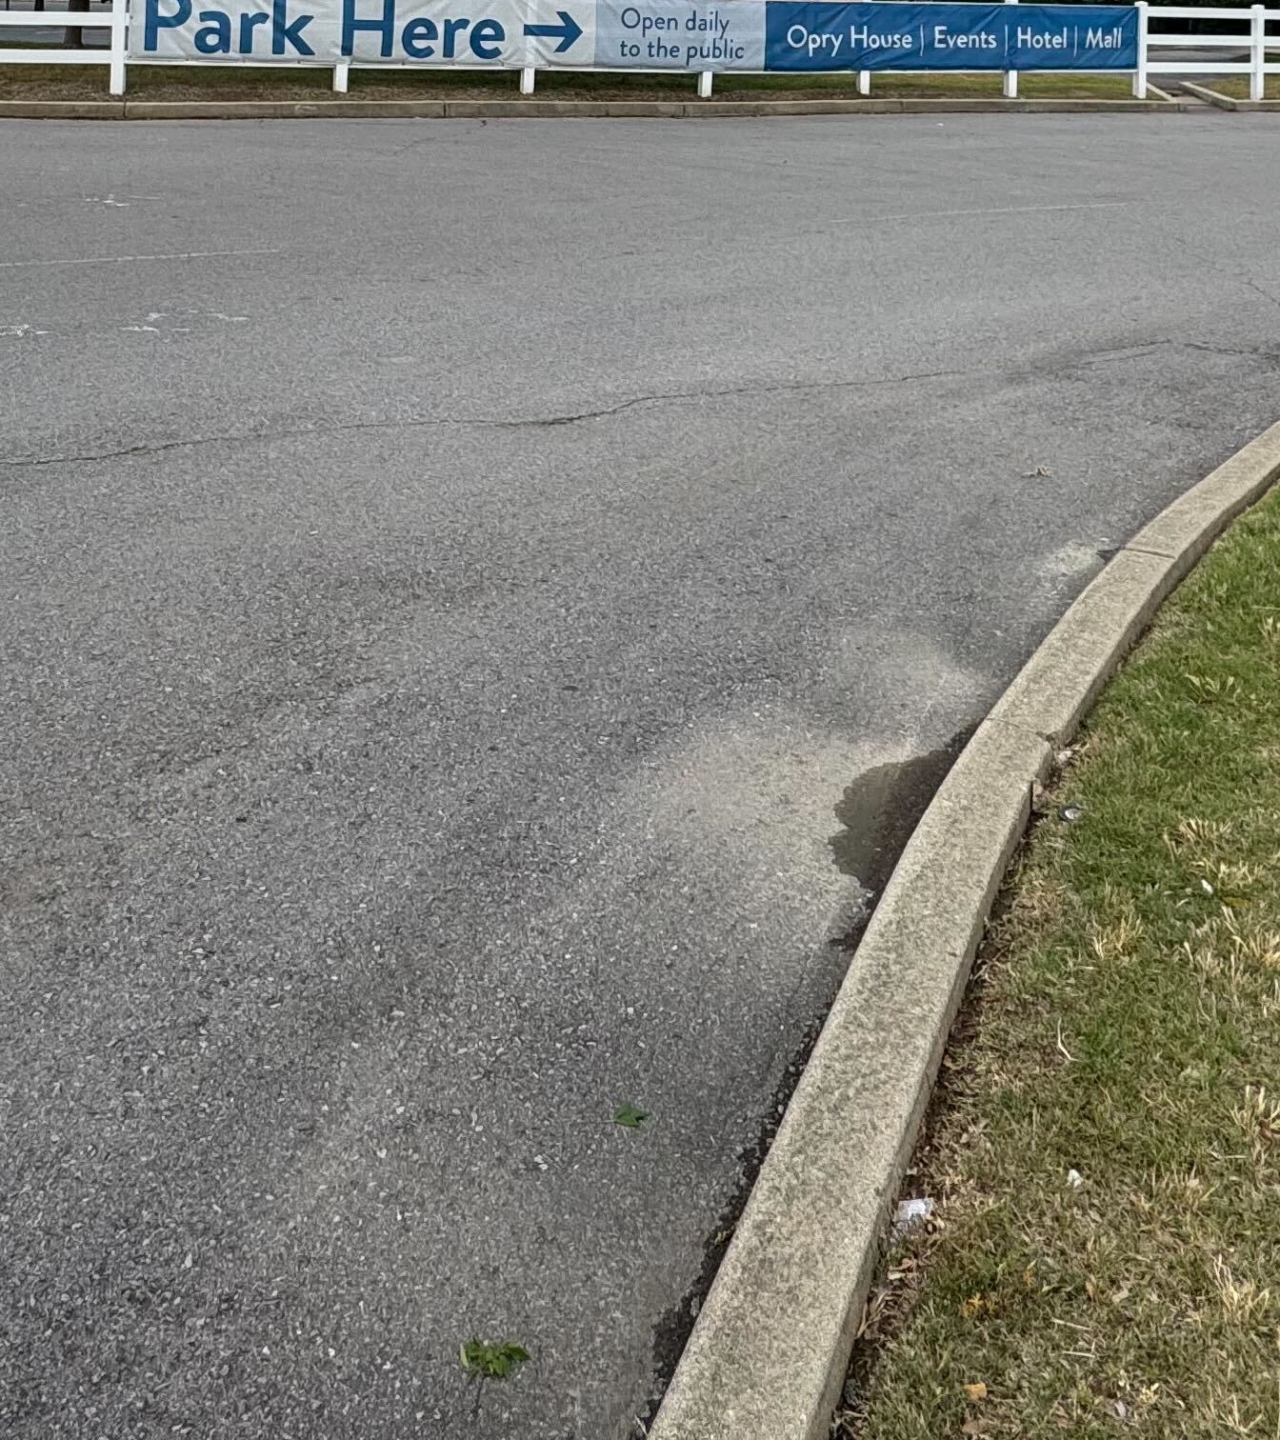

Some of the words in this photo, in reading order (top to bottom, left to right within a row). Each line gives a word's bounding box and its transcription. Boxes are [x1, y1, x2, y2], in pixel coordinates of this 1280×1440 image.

[621, 7, 678, 38] Open
[685, 10, 730, 39] daily
[620, 40, 641, 57] to
[647, 37, 680, 58] the
[686, 38, 745, 66] public
[787, 24, 844, 57] Opry
[850, 25, 913, 49] House
[934, 25, 997, 49] Events
[1017, 26, 1068, 49] Hotel
[1084, 27, 1122, 49] Mall
